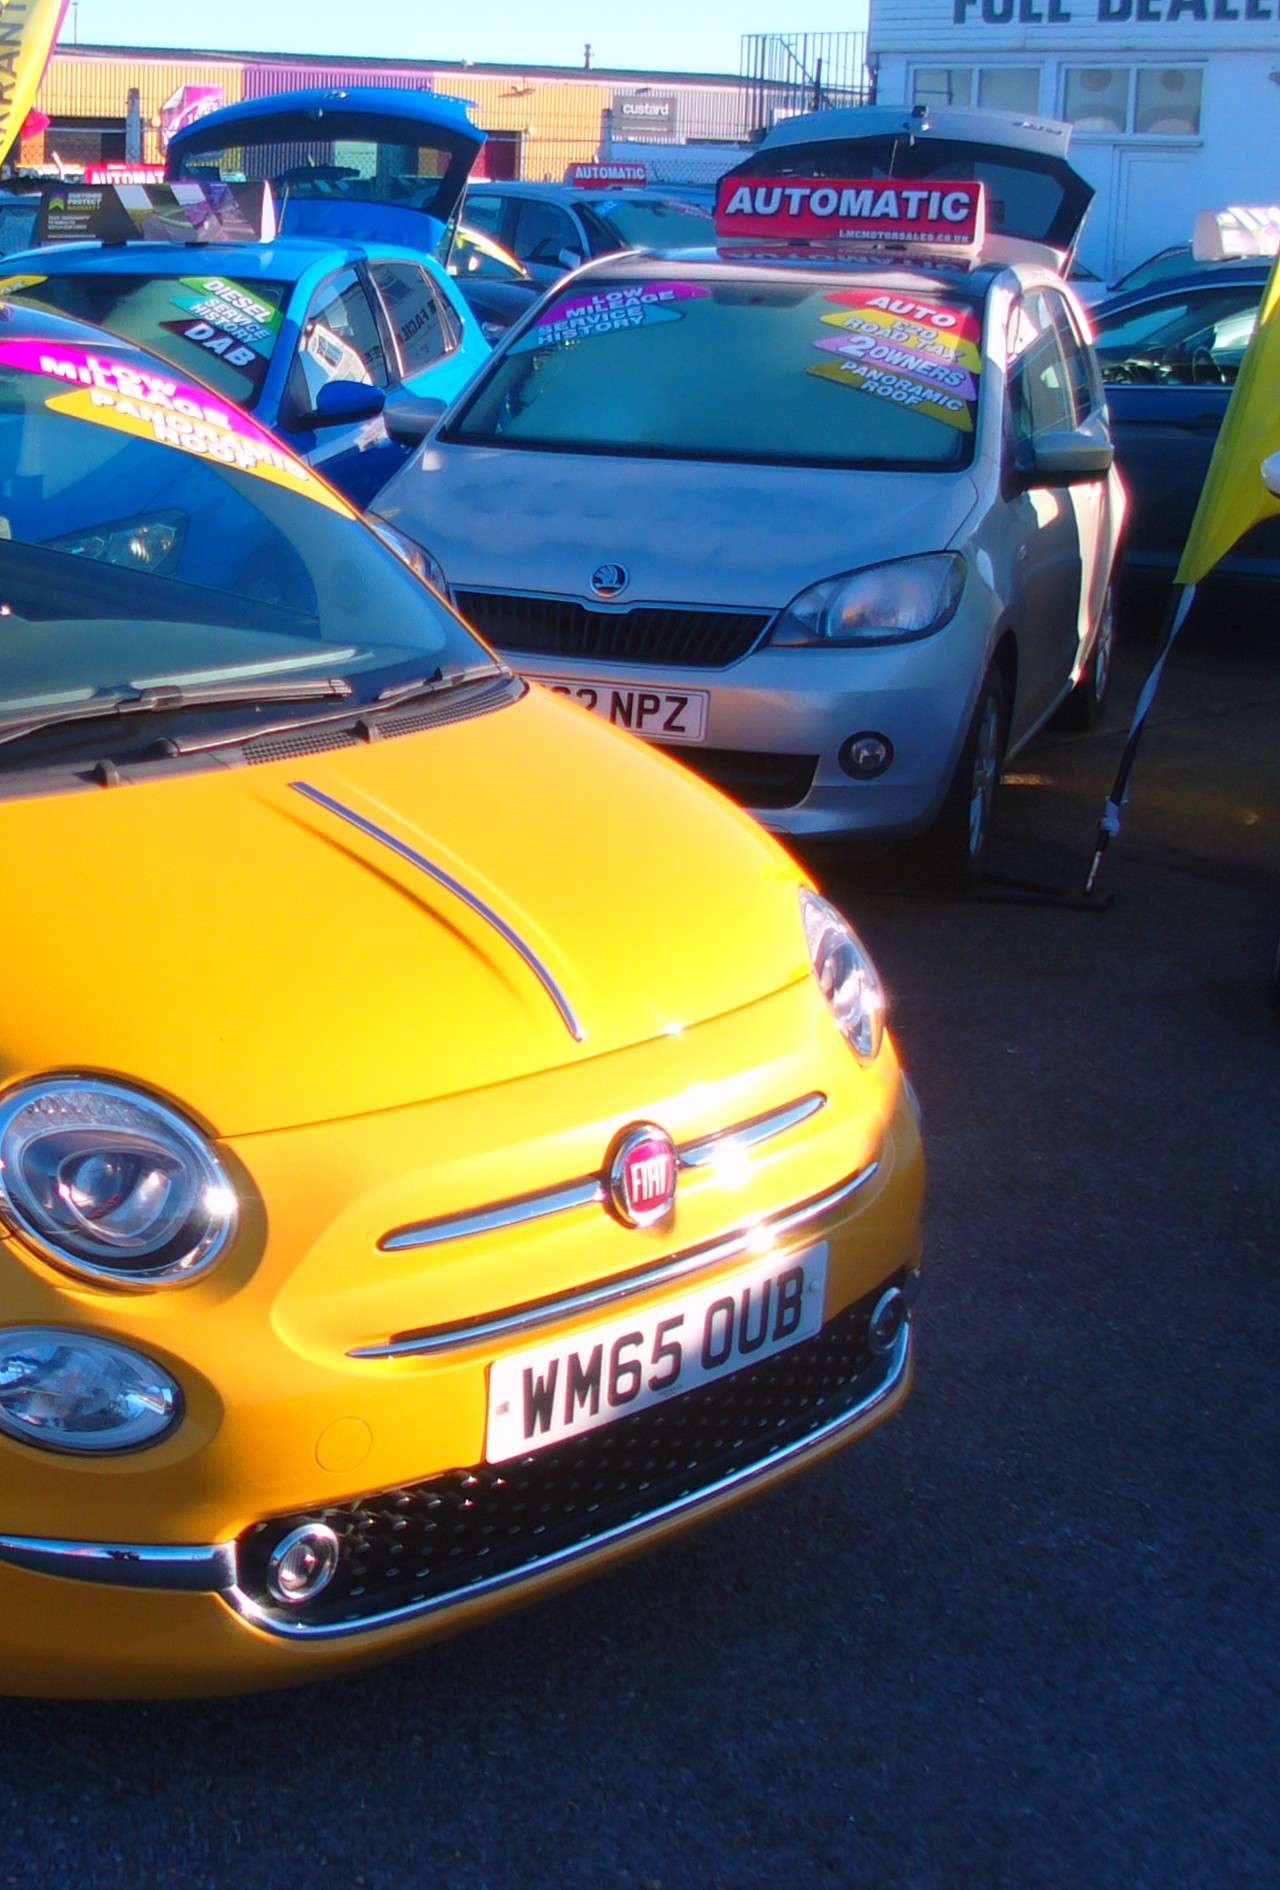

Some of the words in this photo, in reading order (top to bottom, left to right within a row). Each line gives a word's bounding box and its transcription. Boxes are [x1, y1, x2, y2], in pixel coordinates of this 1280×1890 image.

[953, 0, 1072, 24] FULL
[1098, 0, 1280, 22] DEALE
[622, 103, 669, 115] custard
[575, 166, 645, 179] AUTOMATIC
[725, 186, 970, 222] AUTOMATIC
[202, 280, 271, 324] DIESEL
[565, 290, 676, 319] MILEAGE
[592, 287, 644, 305] LOW
[865, 296, 957, 327] AUTO
[189, 303, 259, 344] HISTORY
[205, 298, 272, 339] SERVICE
[537, 305, 644, 334] SERVICE
[537, 315, 644, 345] HISTORY
[184, 322, 256, 366] DAB
[843, 317, 909, 343] ROAD
[915, 338, 963, 363] TAX
[39, 356, 232, 430] MILEAGE
[86, 357, 176, 397] LOW
[841, 361, 963, 412] PANORAMIC
[861, 379, 923, 406] ROOF
[90, 390, 309, 481] PANORAMIC
[152, 411, 259, 469] ROOF
[609, 691, 689, 733] NPZ
[630, 1154, 668, 1203] FIAT
[522, 1313, 685, 1440] WM65
[700, 1265, 805, 1371] OUB
